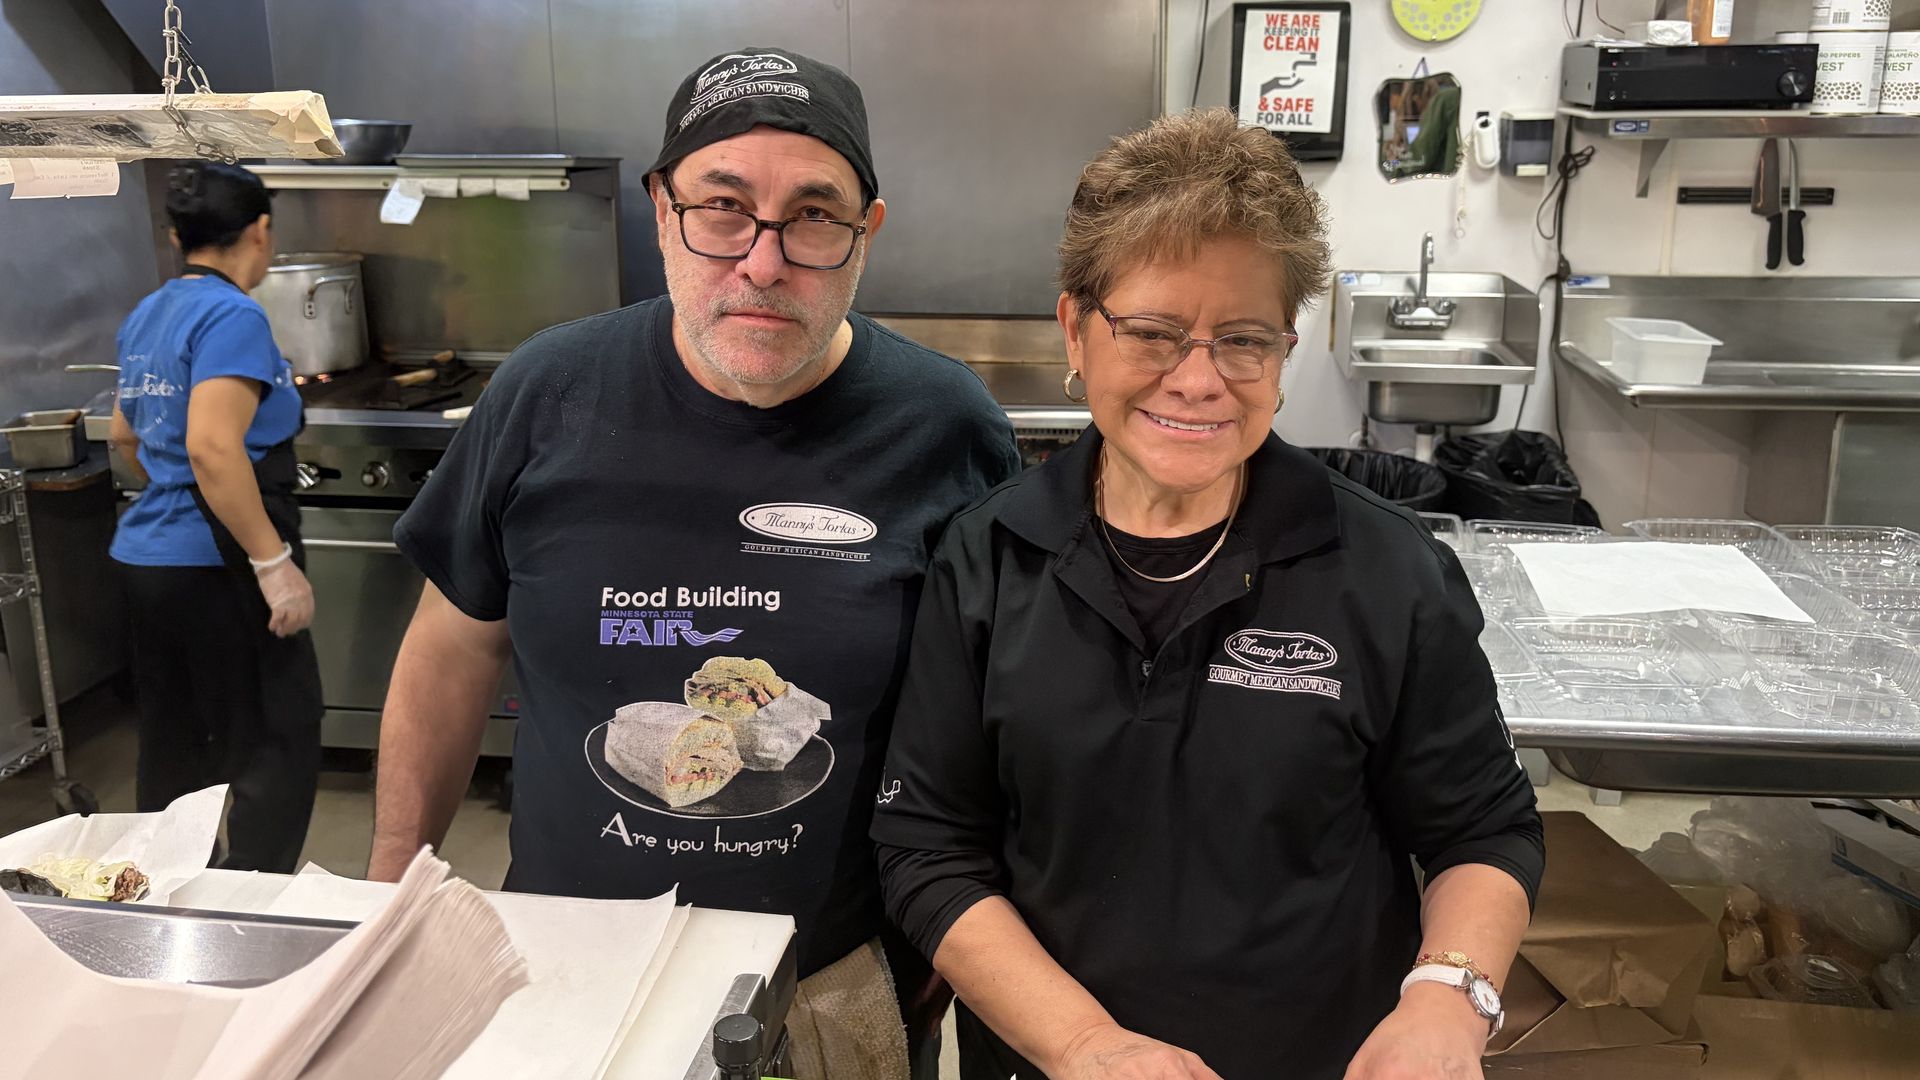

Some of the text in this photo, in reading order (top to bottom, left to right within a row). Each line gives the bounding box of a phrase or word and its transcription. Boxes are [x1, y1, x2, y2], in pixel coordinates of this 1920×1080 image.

[1265, 13, 1320, 28] WE ARE
[1264, 27, 1320, 37] KEEPING IT
[1263, 36, 1319, 51] CLEAN
[694, 57, 783, 97] Manny's Tortas
[746, 83, 809, 100] SANDWICHES
[1258, 97, 1313, 112] & SAFE
[1256, 112, 1313, 125] FOR ALL
[762, 512, 857, 535] Manny's Tortas
[744, 544, 868, 560] GOURMET MEXICAN SANDWICHES
[601, 585, 780, 611] Food Building
[601, 610, 694, 619] MINNESOTA STATE
[600, 618, 744, 646] FAIR
[1233, 636, 1325, 664] Manny's Tortas
[1209, 667, 1341, 696] GOURMET MEXICAN SANDWICHES
[600, 812, 804, 857] Are you hungry?
